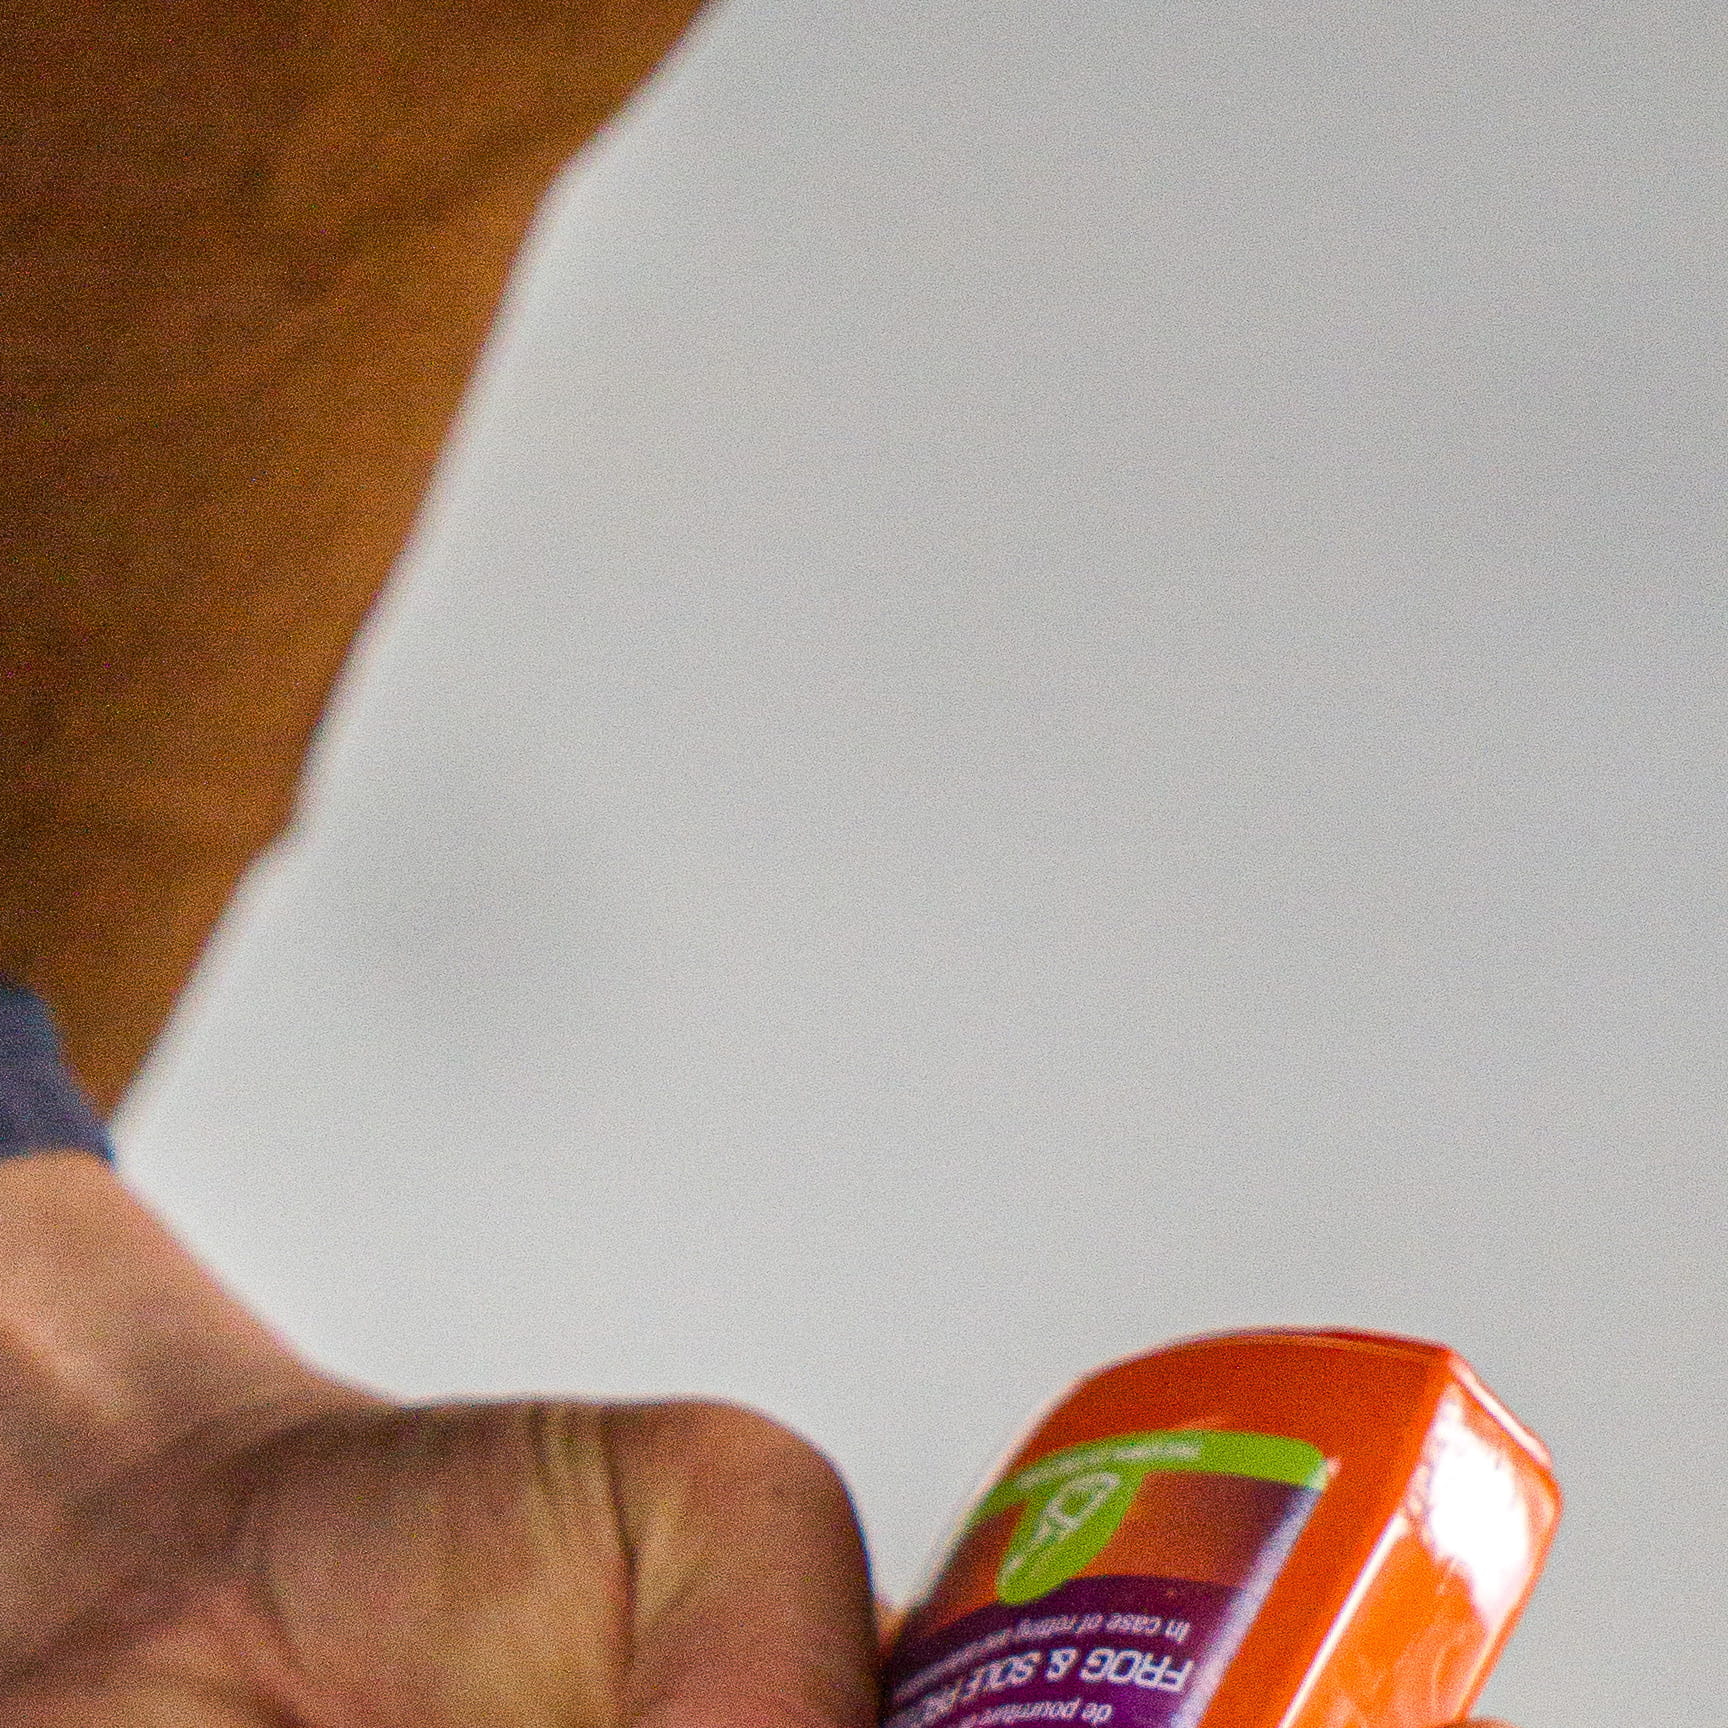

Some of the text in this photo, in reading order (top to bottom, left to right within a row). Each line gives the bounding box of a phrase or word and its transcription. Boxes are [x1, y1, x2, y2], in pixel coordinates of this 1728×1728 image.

[1106, 1612, 1164, 1638] case
[1164, 1619, 1191, 1645] In
[1046, 1648, 1078, 1682] &
[1080, 1648, 1194, 1693] FROG
[1080, 1702, 1114, 1728] de
